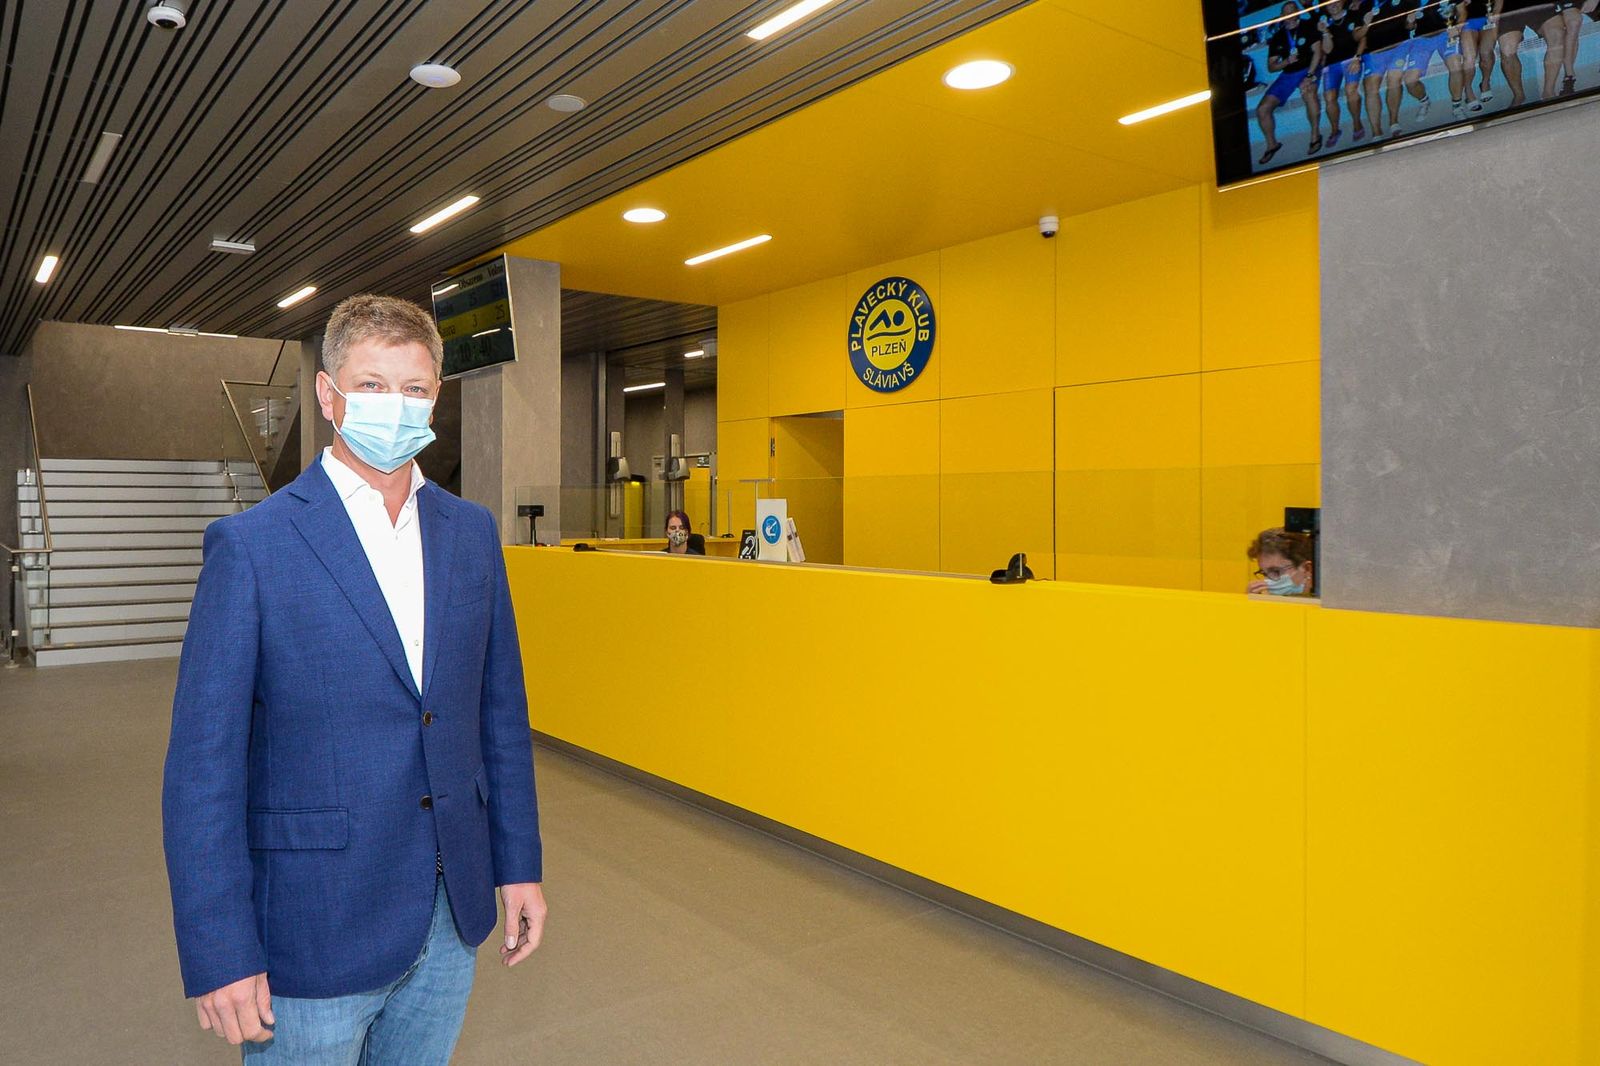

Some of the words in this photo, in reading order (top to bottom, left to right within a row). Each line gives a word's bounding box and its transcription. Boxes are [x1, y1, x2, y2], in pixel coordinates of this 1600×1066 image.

[851, 280, 908, 352] PLAVECKÝ
[907, 290, 930, 342] KLUB
[871, 339, 907, 357] PLZEŇ
[863, 367, 900, 388] SLÁVIA
[898, 361, 915, 382] VŠ
